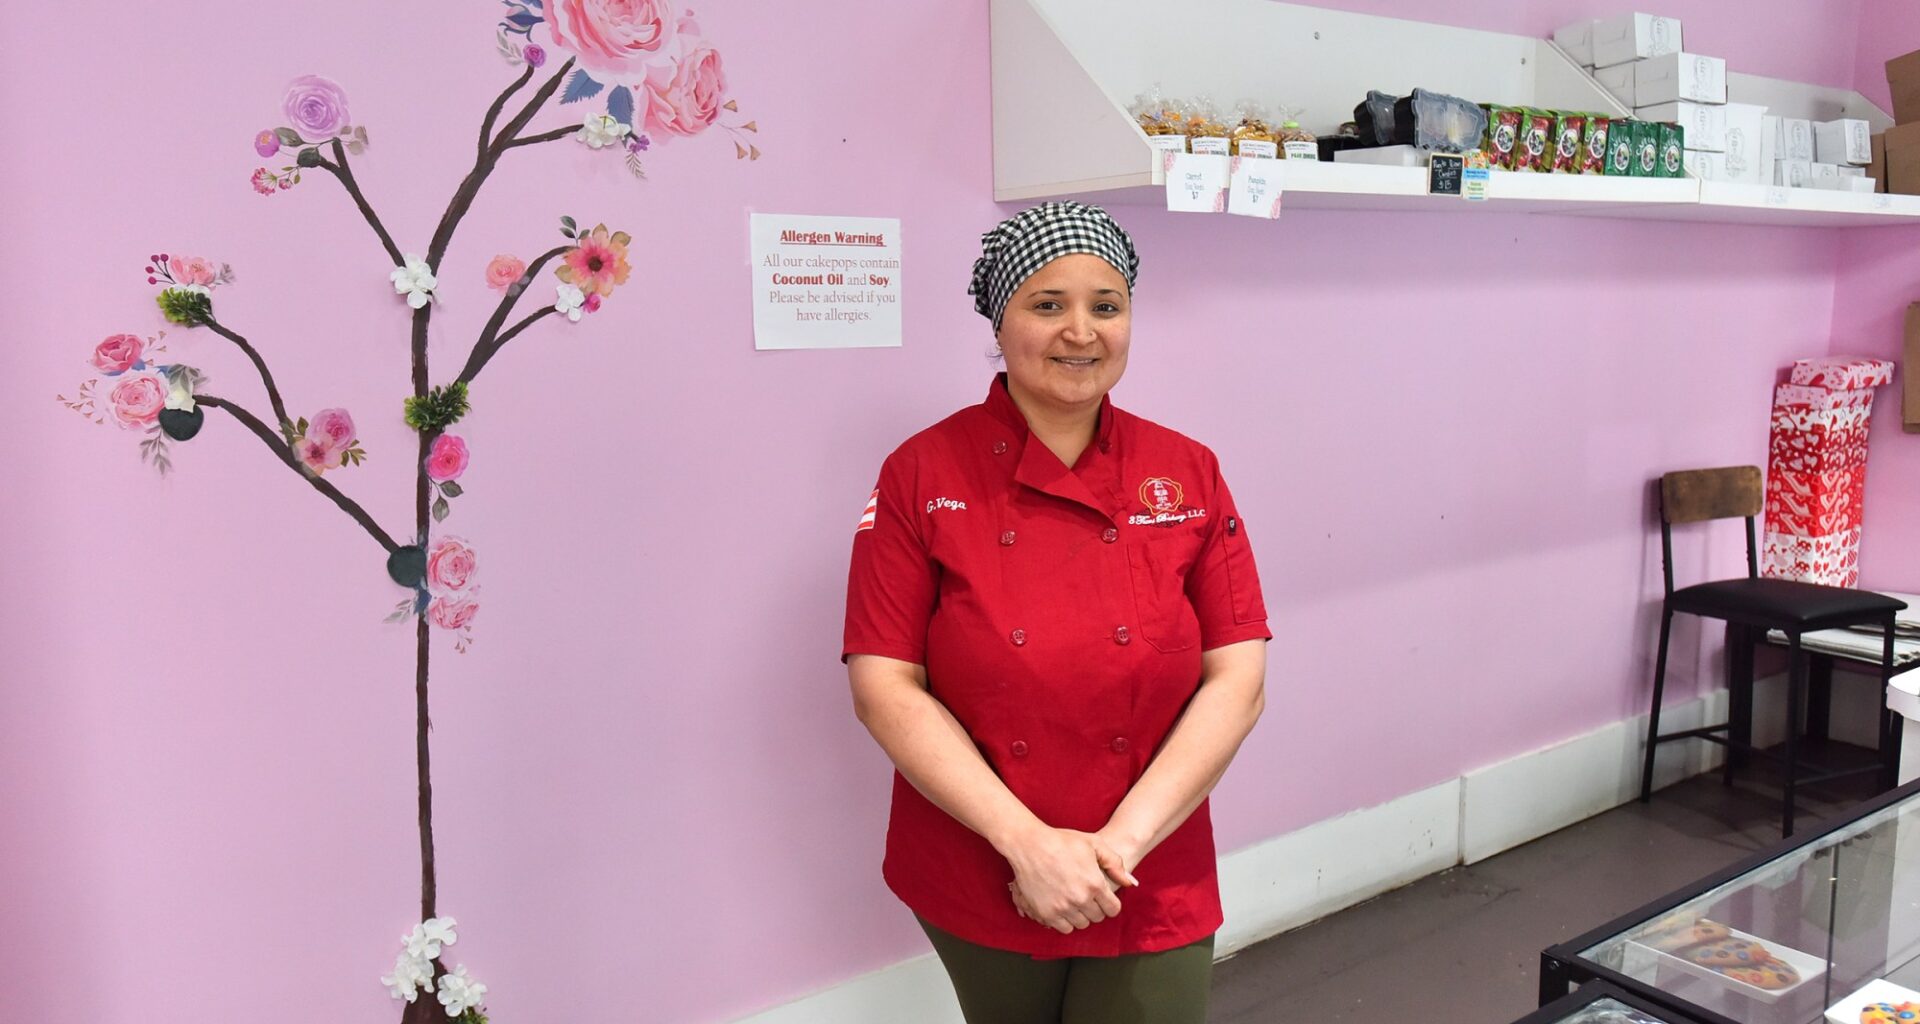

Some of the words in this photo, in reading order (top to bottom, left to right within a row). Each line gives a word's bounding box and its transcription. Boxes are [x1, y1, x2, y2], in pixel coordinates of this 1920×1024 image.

[780, 230, 830, 244] Allergen
[835, 231, 884, 246] Warning
[763, 254, 779, 267] All
[783, 257, 802, 267] our
[805, 255, 857, 271] cakepops
[860, 257, 899, 269] contain
[772, 273, 823, 285] Coconut
[827, 274, 843, 285] Oil
[847, 274, 867, 286] and
[769, 291, 805, 303] Please
[807, 291, 821, 303] be
[823, 291, 864, 303] advised
[867, 291, 875, 303] if
[877, 294, 896, 306] you
[796, 308, 822, 321] have
[824, 308, 871, 324] allergies.
[1188, 509, 1206, 518] LLC
